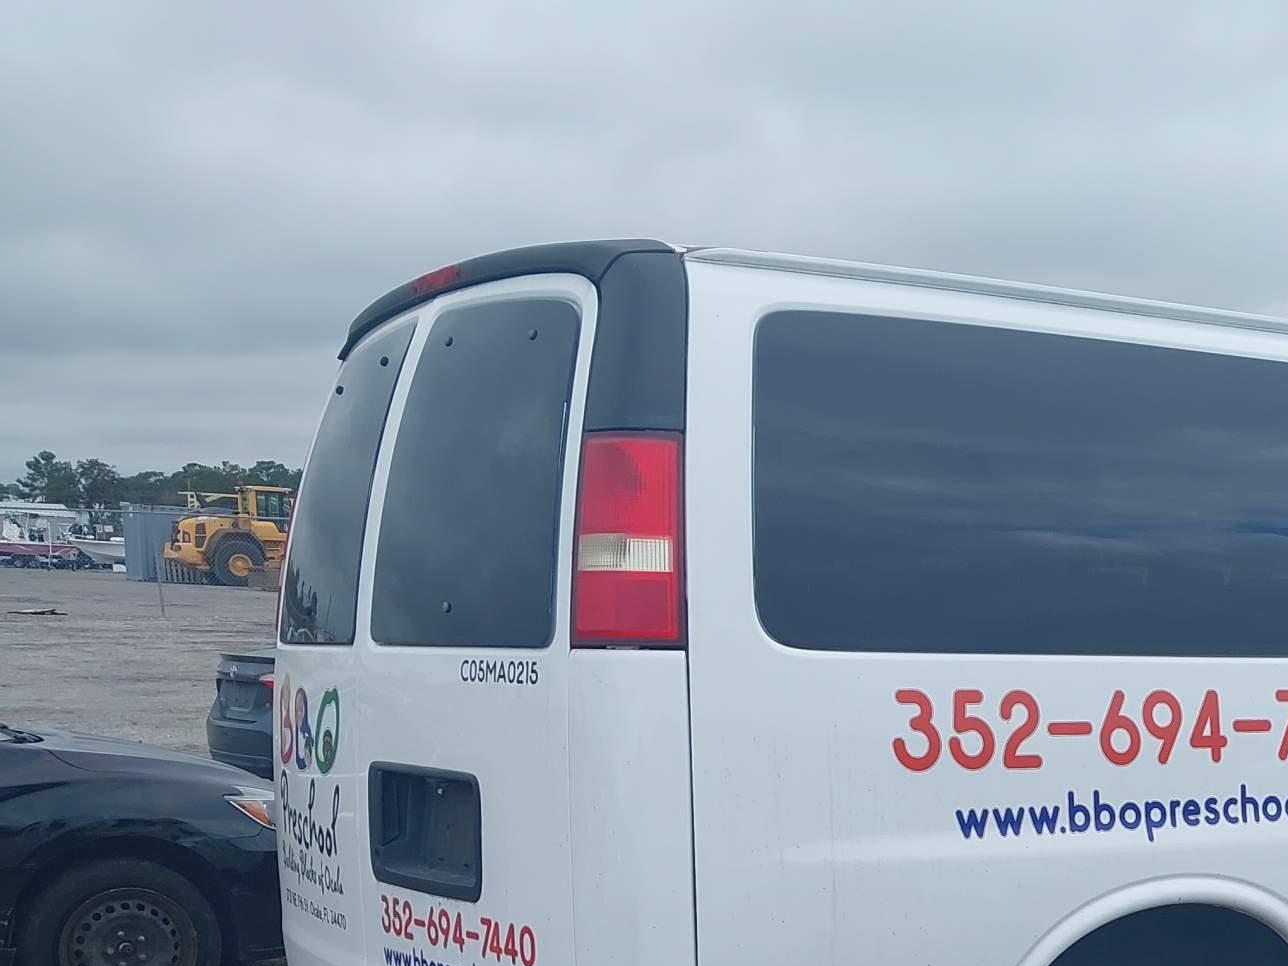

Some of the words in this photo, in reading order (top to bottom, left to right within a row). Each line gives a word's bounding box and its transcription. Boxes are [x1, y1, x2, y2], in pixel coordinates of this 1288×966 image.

[461, 660, 539, 685] C05MA0215
[281, 770, 341, 857] Preschool
[325, 865, 344, 895] Ocala
